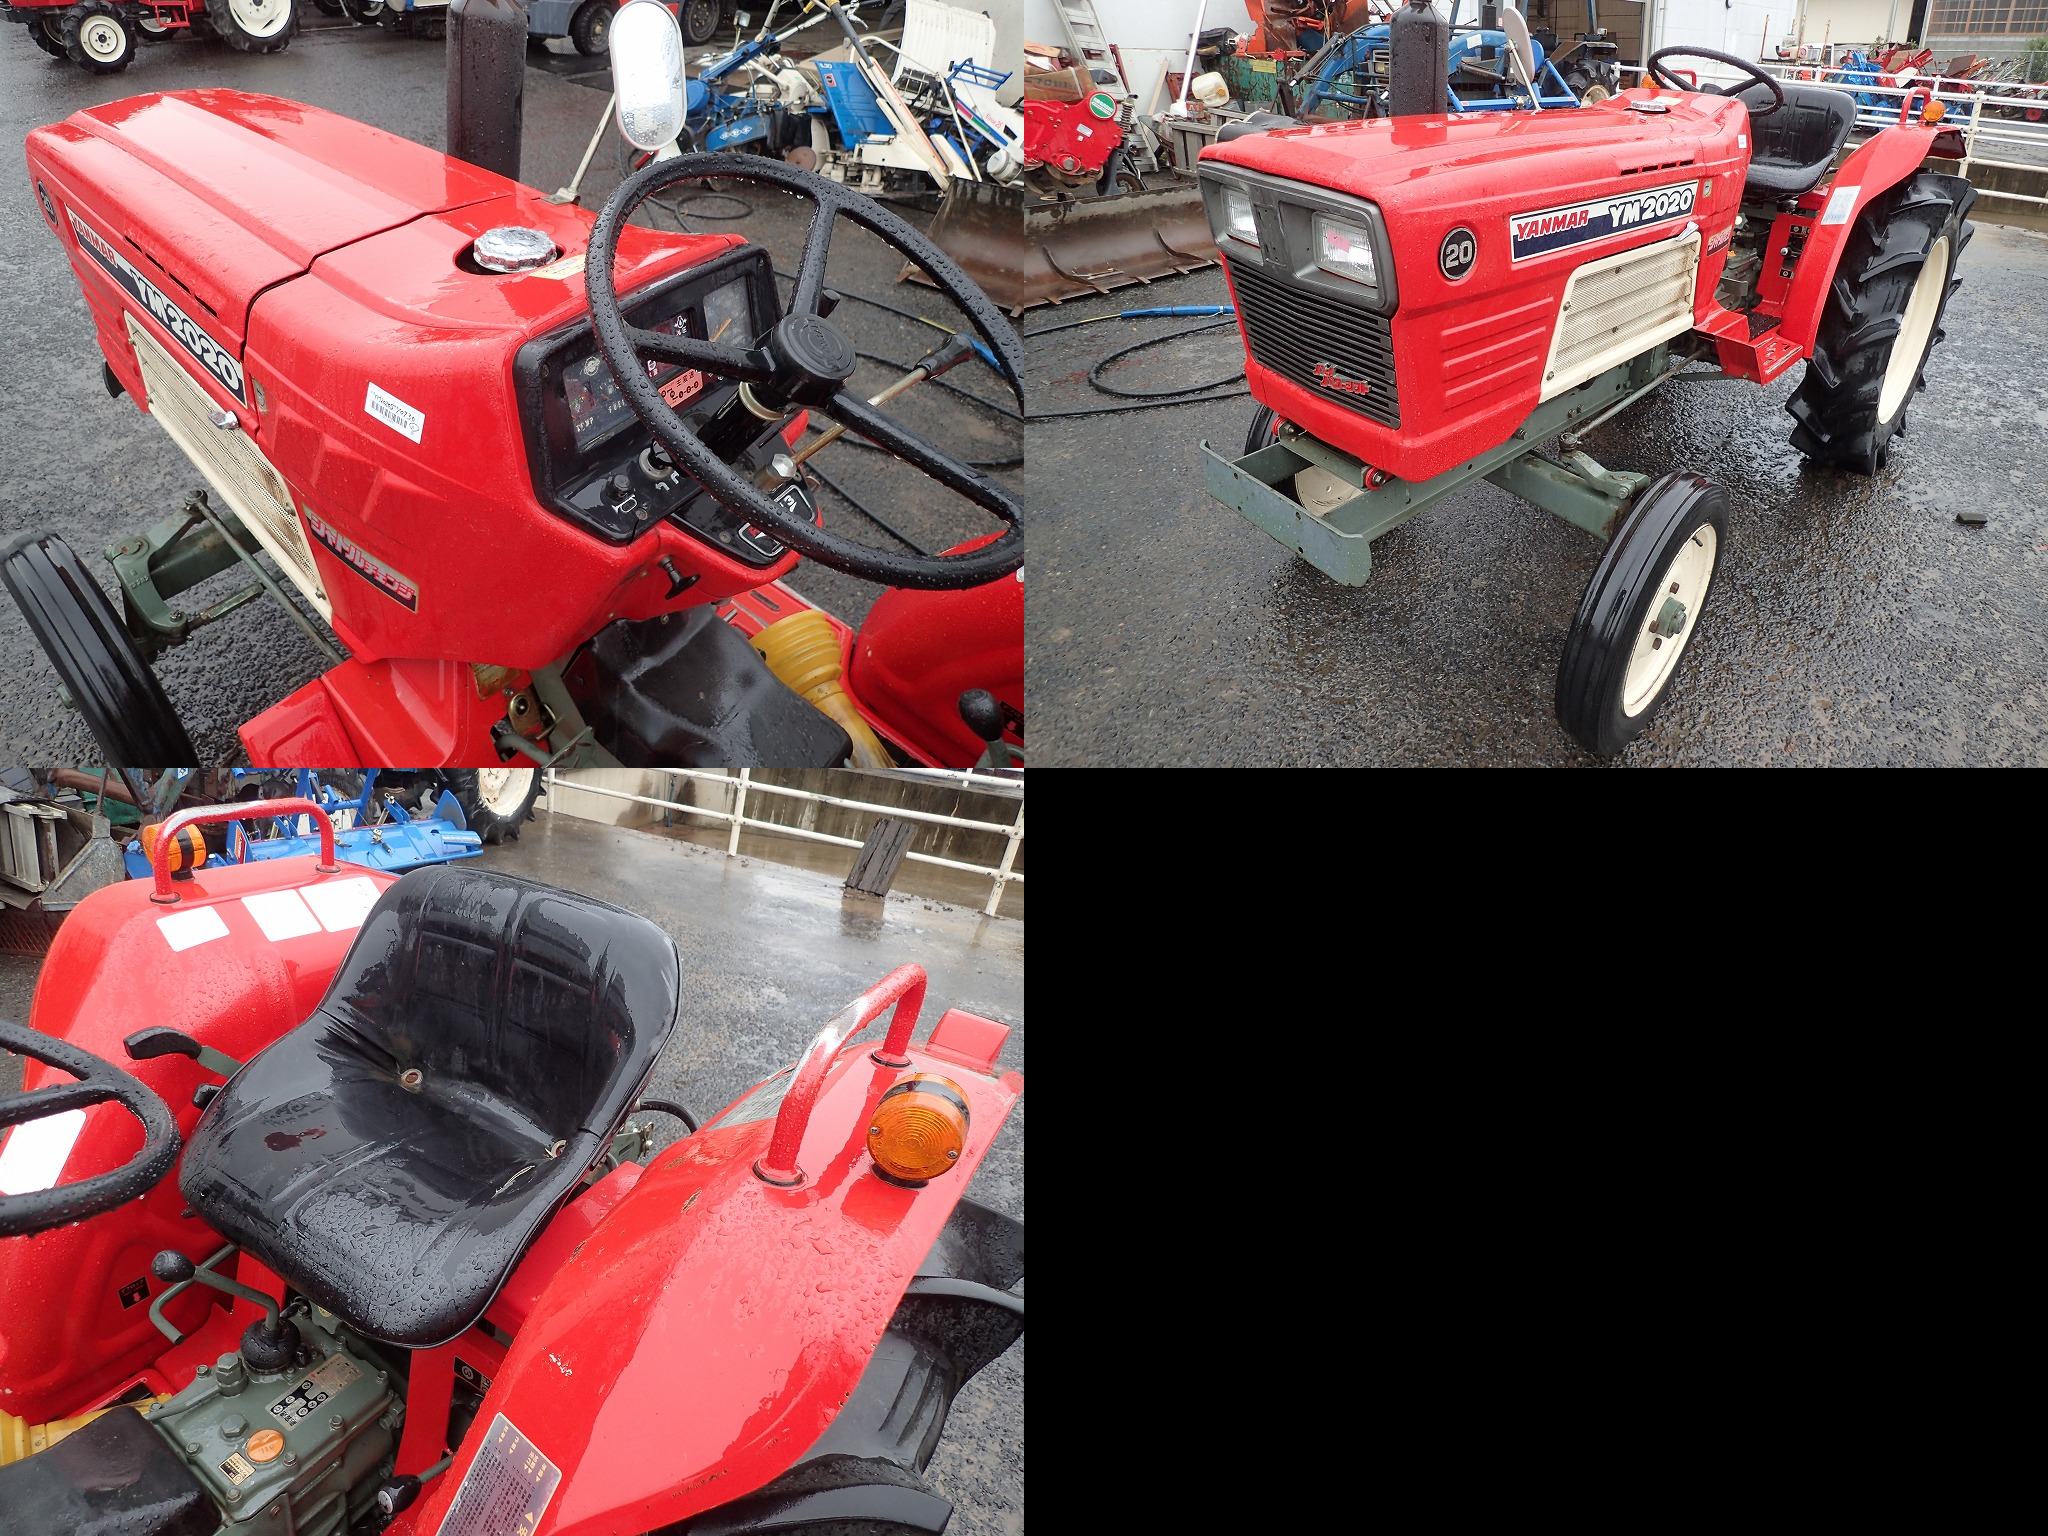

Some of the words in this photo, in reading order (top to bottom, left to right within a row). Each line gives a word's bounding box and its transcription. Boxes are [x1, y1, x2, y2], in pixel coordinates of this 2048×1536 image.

[1516, 209, 1589, 241] YANMAR
[1608, 187, 1694, 229] YM2020
[1445, 240, 1473, 268] 20
[70, 213, 118, 268] YANMAR
[130, 268, 239, 390] YM2020
[309, 512, 416, 601] シャトルチェンジ
